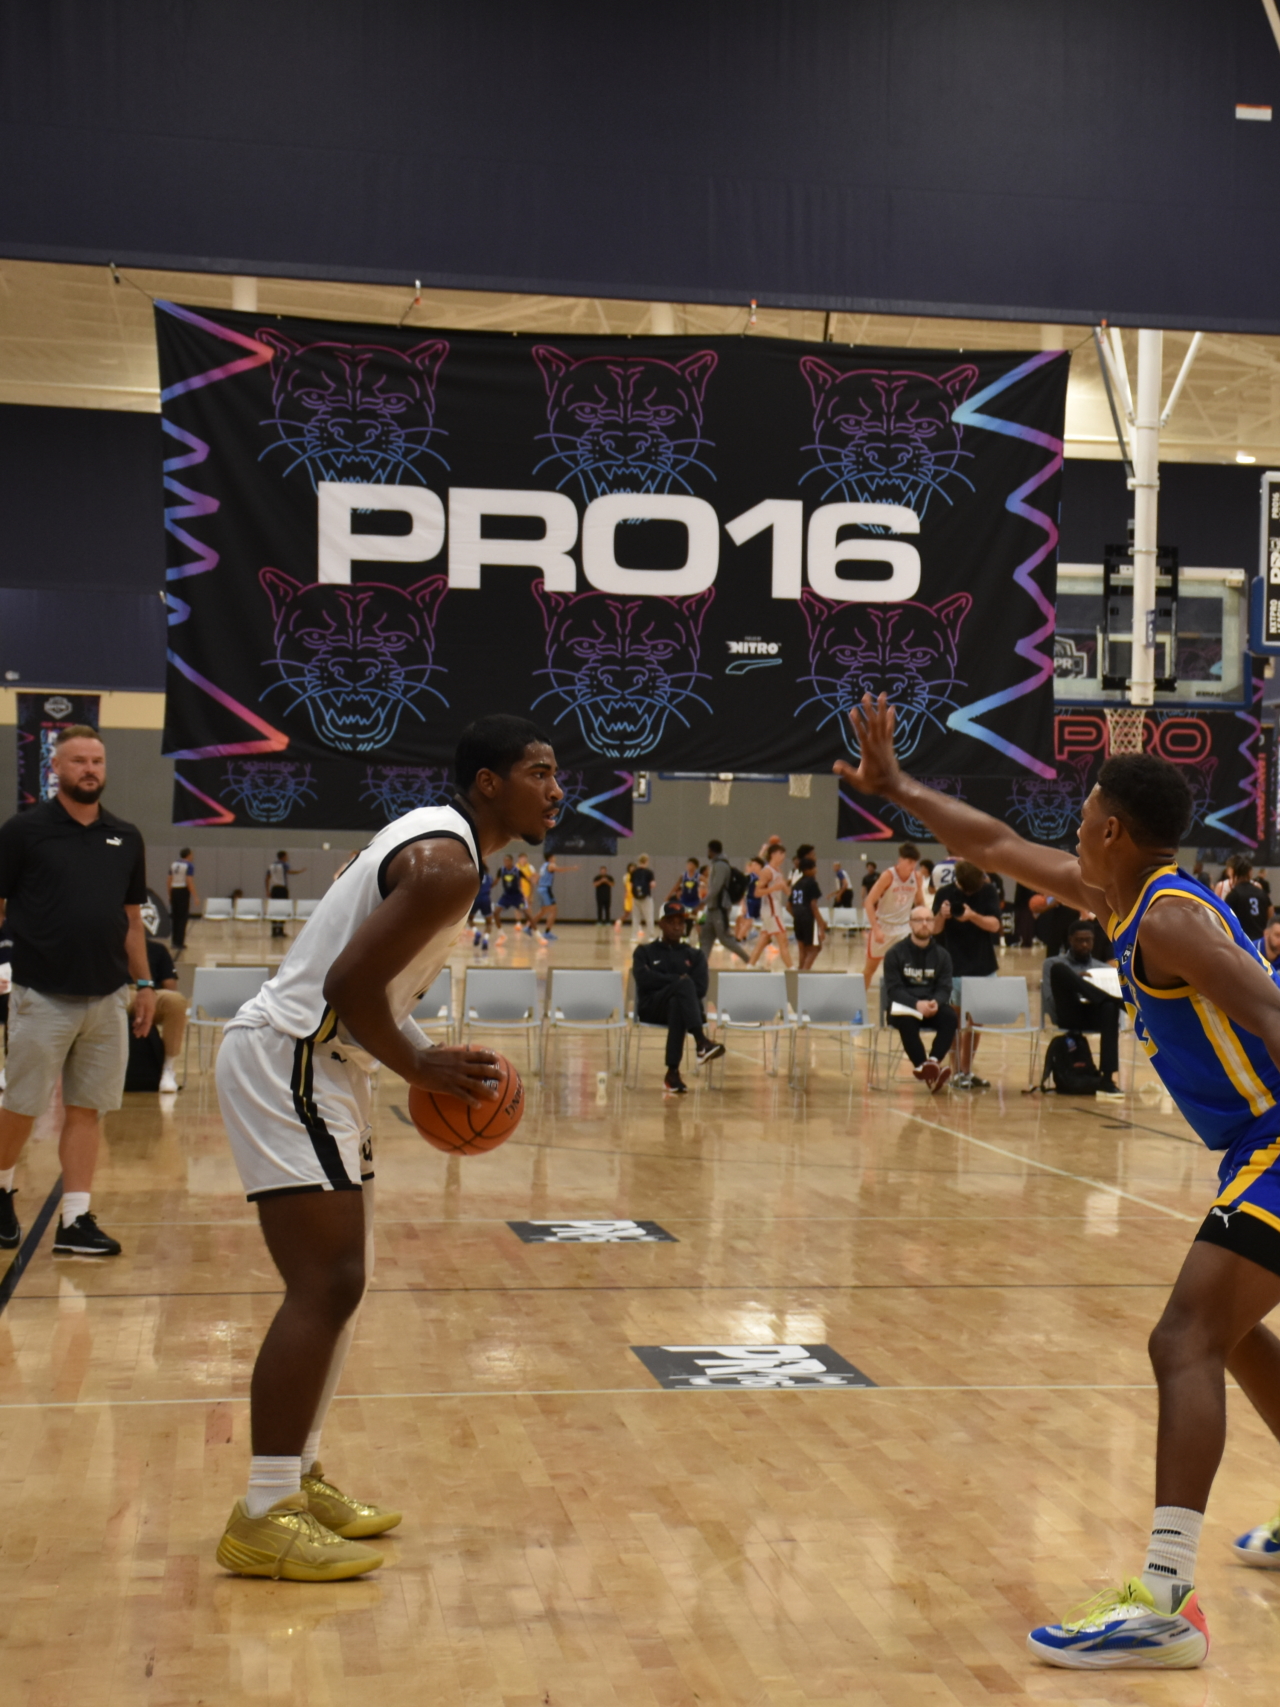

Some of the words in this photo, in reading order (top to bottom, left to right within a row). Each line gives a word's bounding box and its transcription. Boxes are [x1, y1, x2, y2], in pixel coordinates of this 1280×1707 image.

[317, 481, 922, 602] PRO16
[725, 641, 779, 655] NITRO
[1249, 898, 1260, 915] 3
[1148, 1562, 1177, 1576] PUMA
